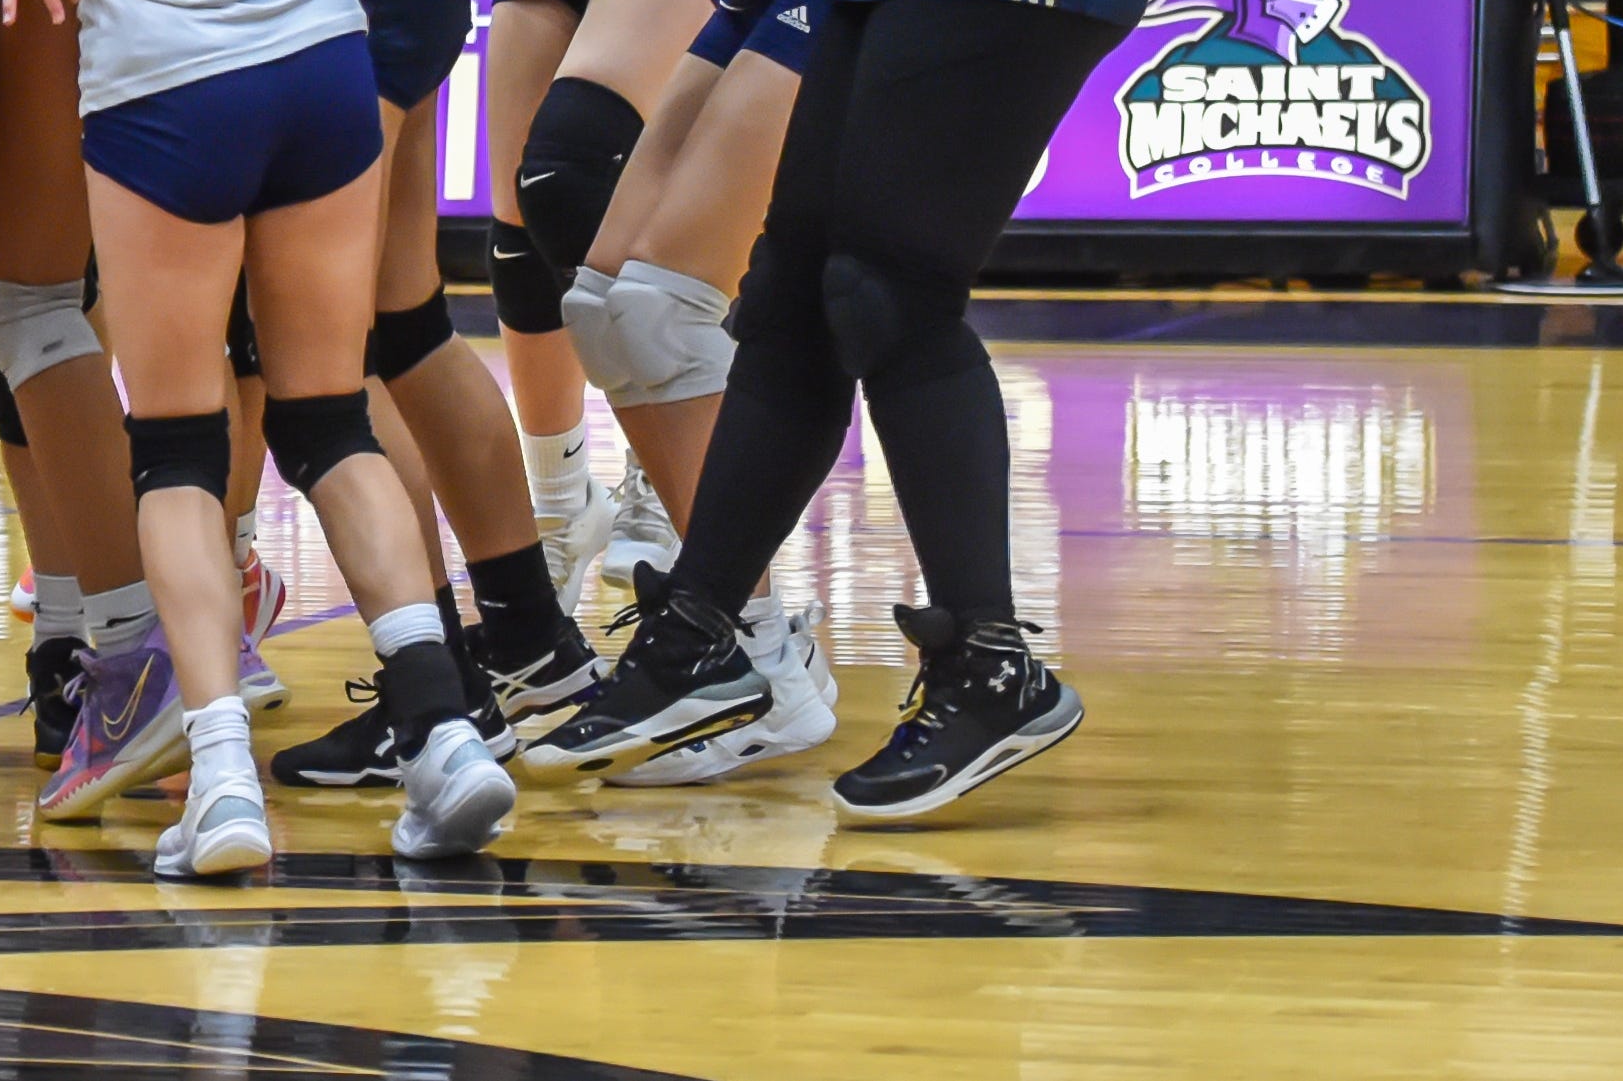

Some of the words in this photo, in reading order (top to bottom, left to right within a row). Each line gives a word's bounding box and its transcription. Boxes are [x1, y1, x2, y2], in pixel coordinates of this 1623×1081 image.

[1161, 63, 1387, 102] SAINT
[1128, 99, 1423, 168] MICHAEL'S
[1153, 151, 1385, 185] COLLEGE
